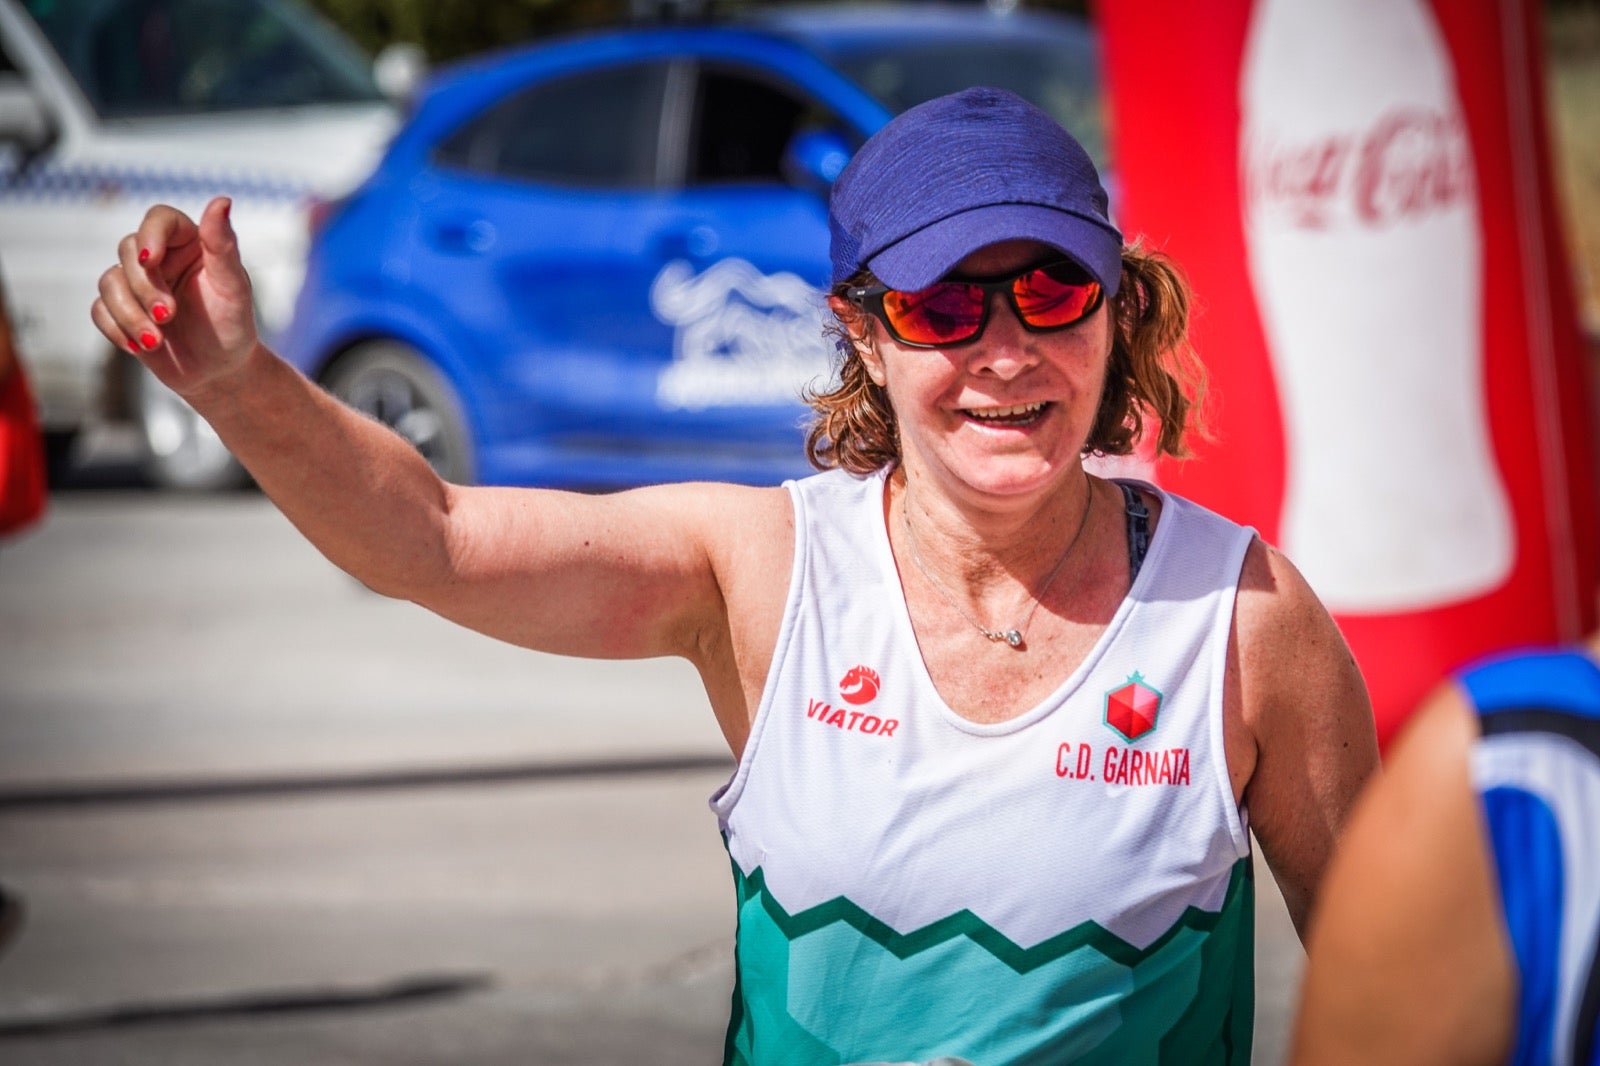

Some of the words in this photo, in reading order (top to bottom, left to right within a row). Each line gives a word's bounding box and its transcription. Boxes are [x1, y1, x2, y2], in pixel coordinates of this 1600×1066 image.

[807, 698, 899, 737] VIATOR
[1055, 742, 1095, 782] C.D.
[1103, 746, 1190, 786] GARNATA
